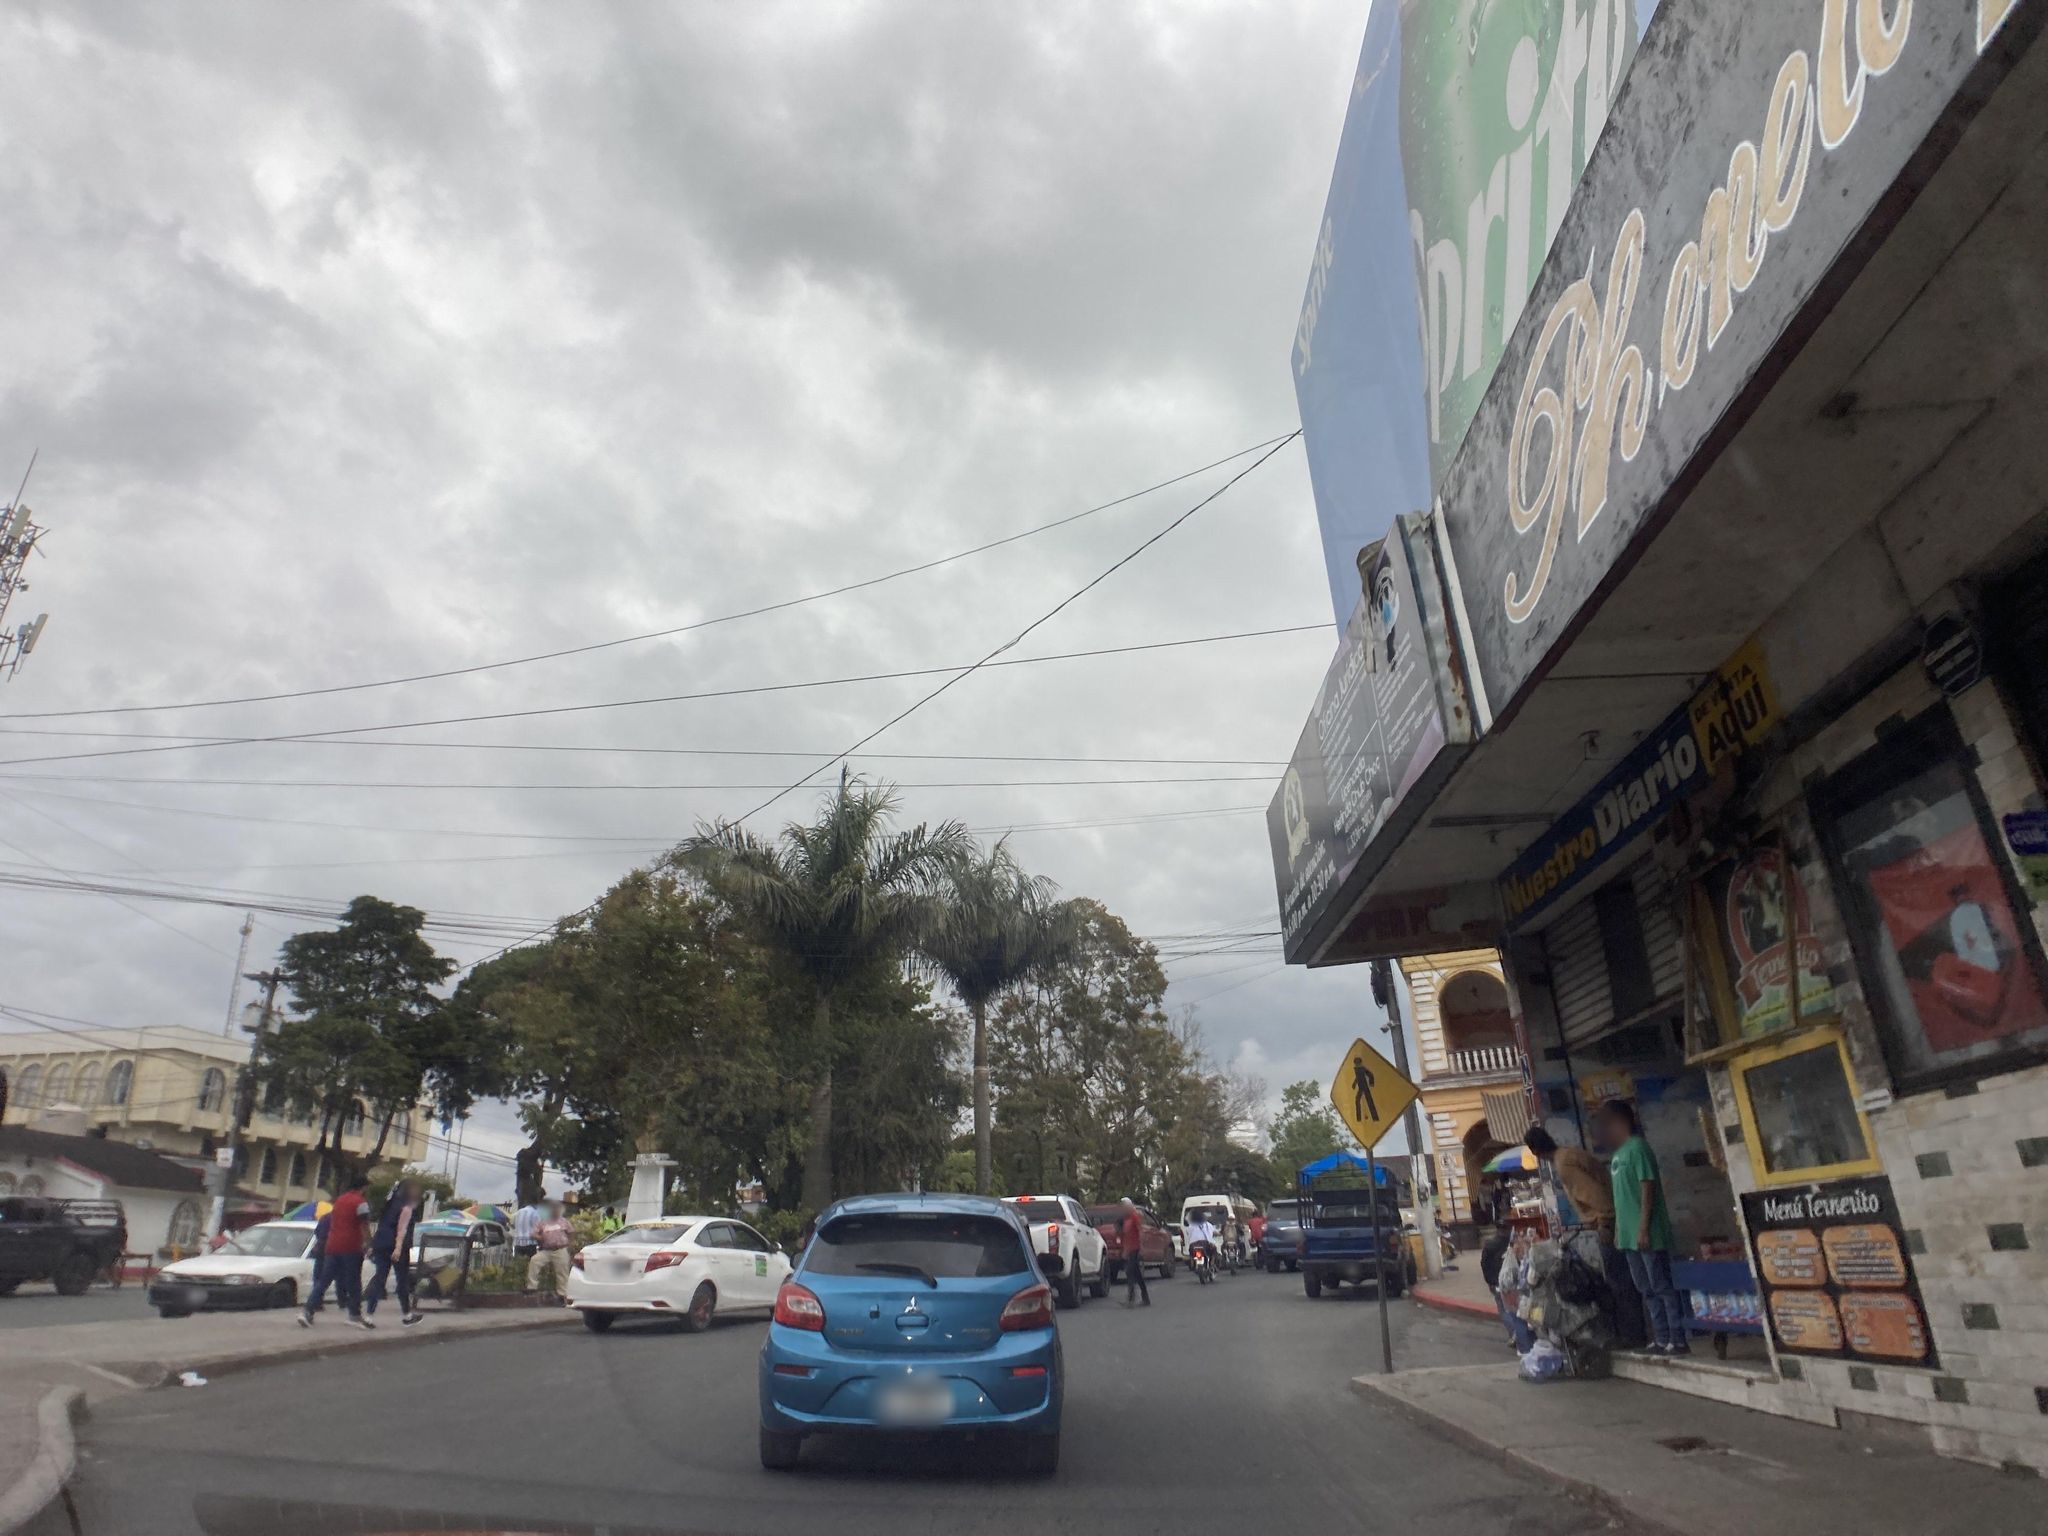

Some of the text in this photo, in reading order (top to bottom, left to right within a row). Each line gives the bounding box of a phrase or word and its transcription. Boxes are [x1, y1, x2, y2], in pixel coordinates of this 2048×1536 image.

[1502, 734, 1698, 918] Nuestro Diario
[1764, 1188, 1880, 1222] Menú Ternerito
